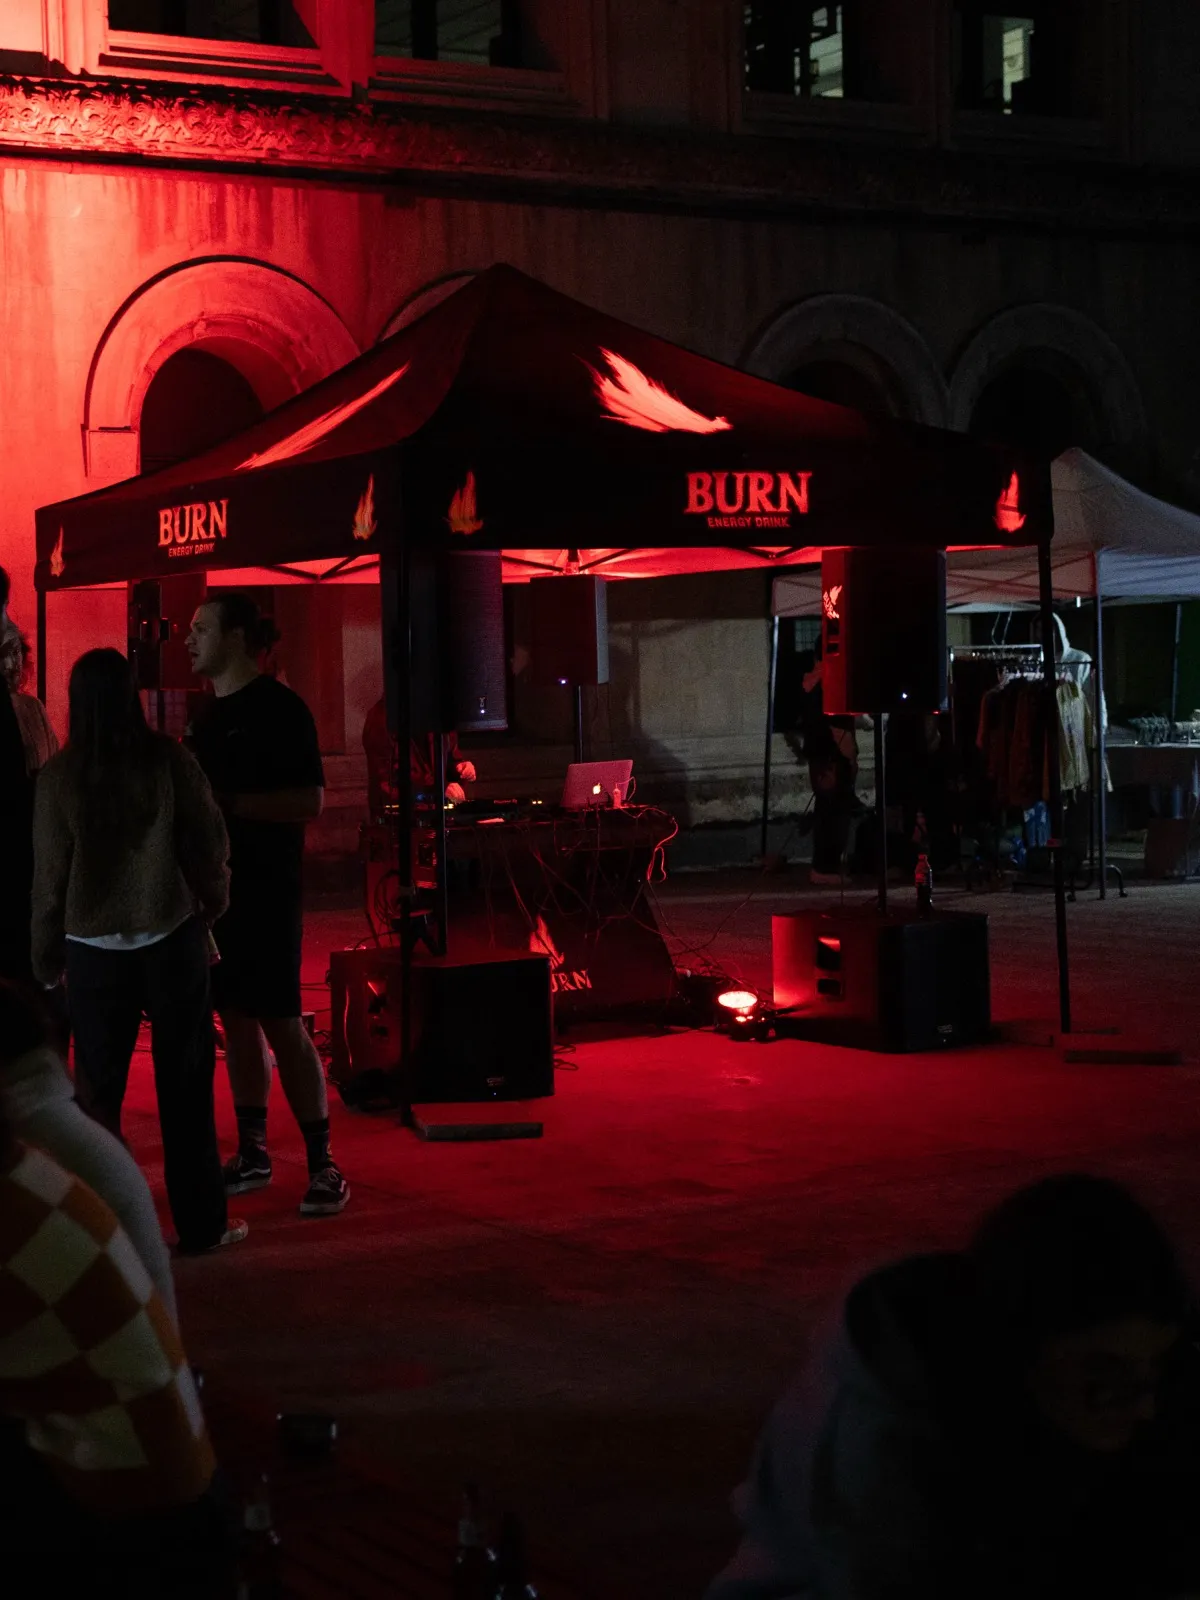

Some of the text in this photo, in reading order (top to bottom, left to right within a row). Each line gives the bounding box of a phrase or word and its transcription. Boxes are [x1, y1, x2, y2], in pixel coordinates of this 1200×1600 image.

[684, 471, 813, 514] BURN
[158, 500, 229, 547] BURN
[707, 517, 791, 529] ENERGY DRINK
[168, 542, 215, 558] ENERGY DRINK
[551, 968, 593, 993] RN
